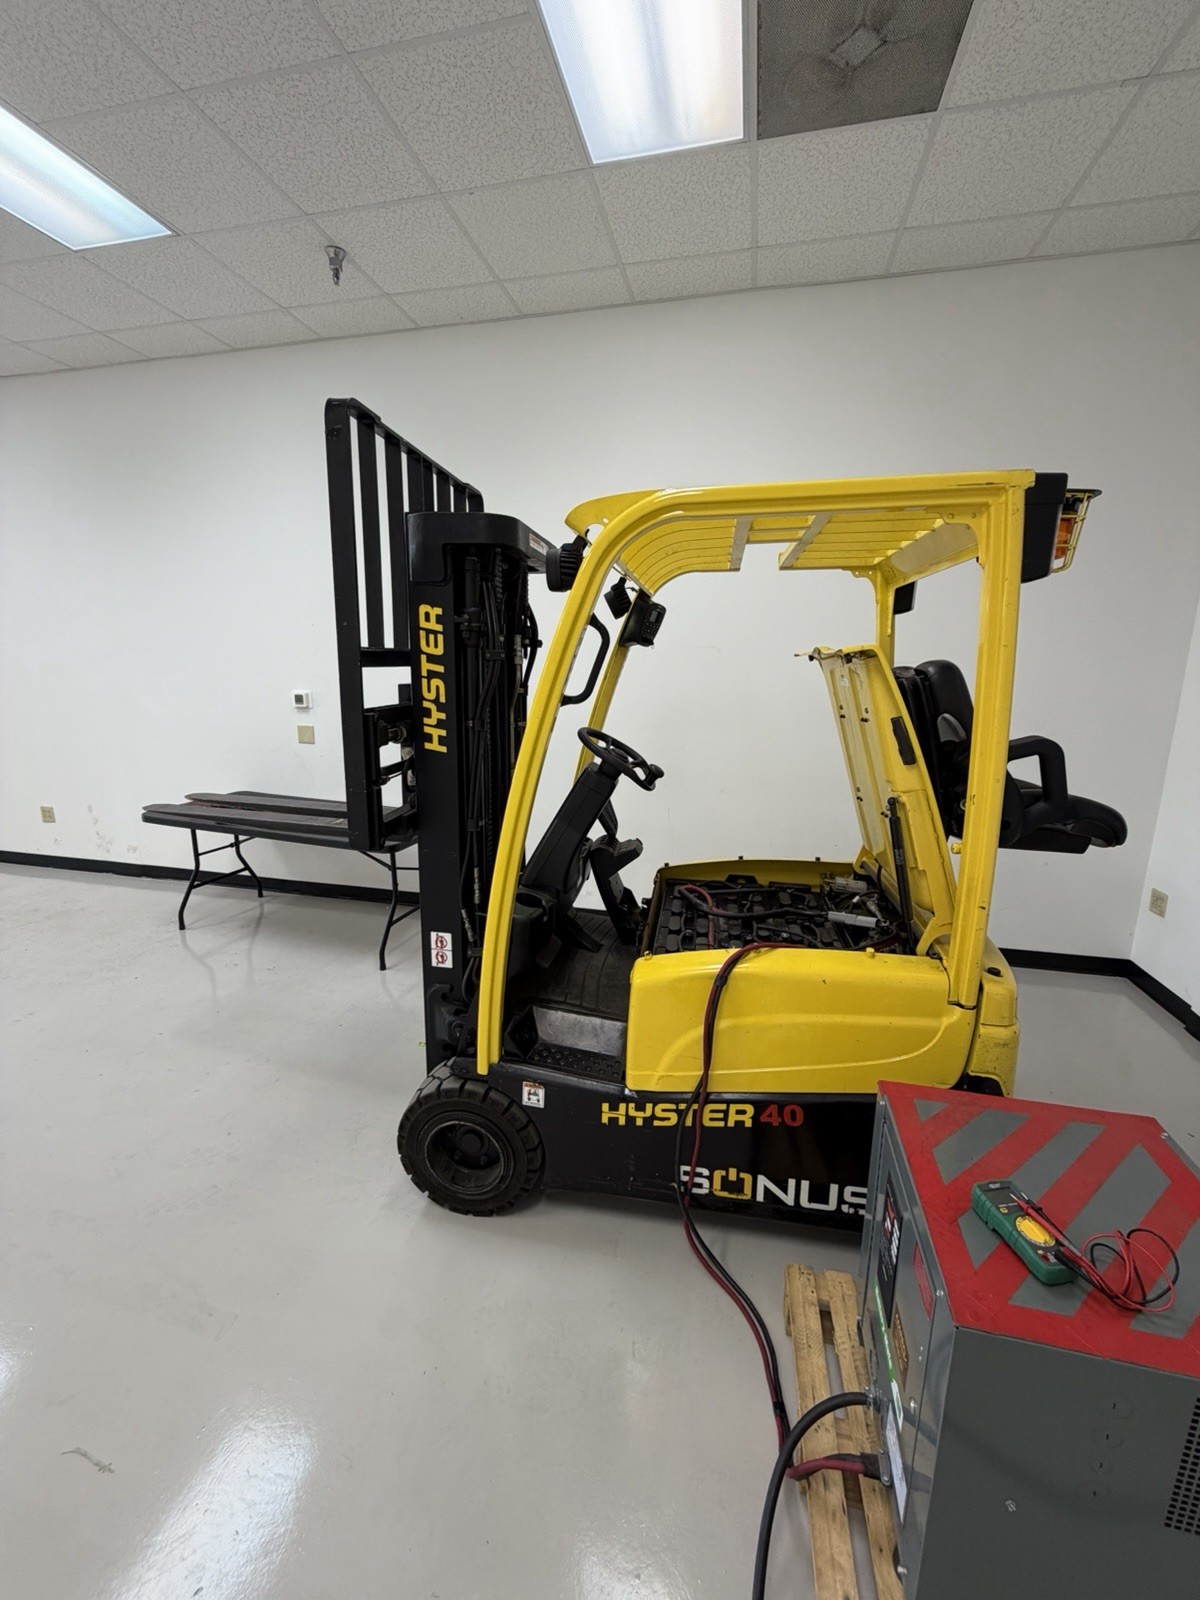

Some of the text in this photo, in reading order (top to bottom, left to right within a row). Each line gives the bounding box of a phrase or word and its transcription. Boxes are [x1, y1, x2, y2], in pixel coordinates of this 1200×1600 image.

[418, 603, 448, 754] HYSTER
[601, 1102, 804, 1128] HYSTER 40
